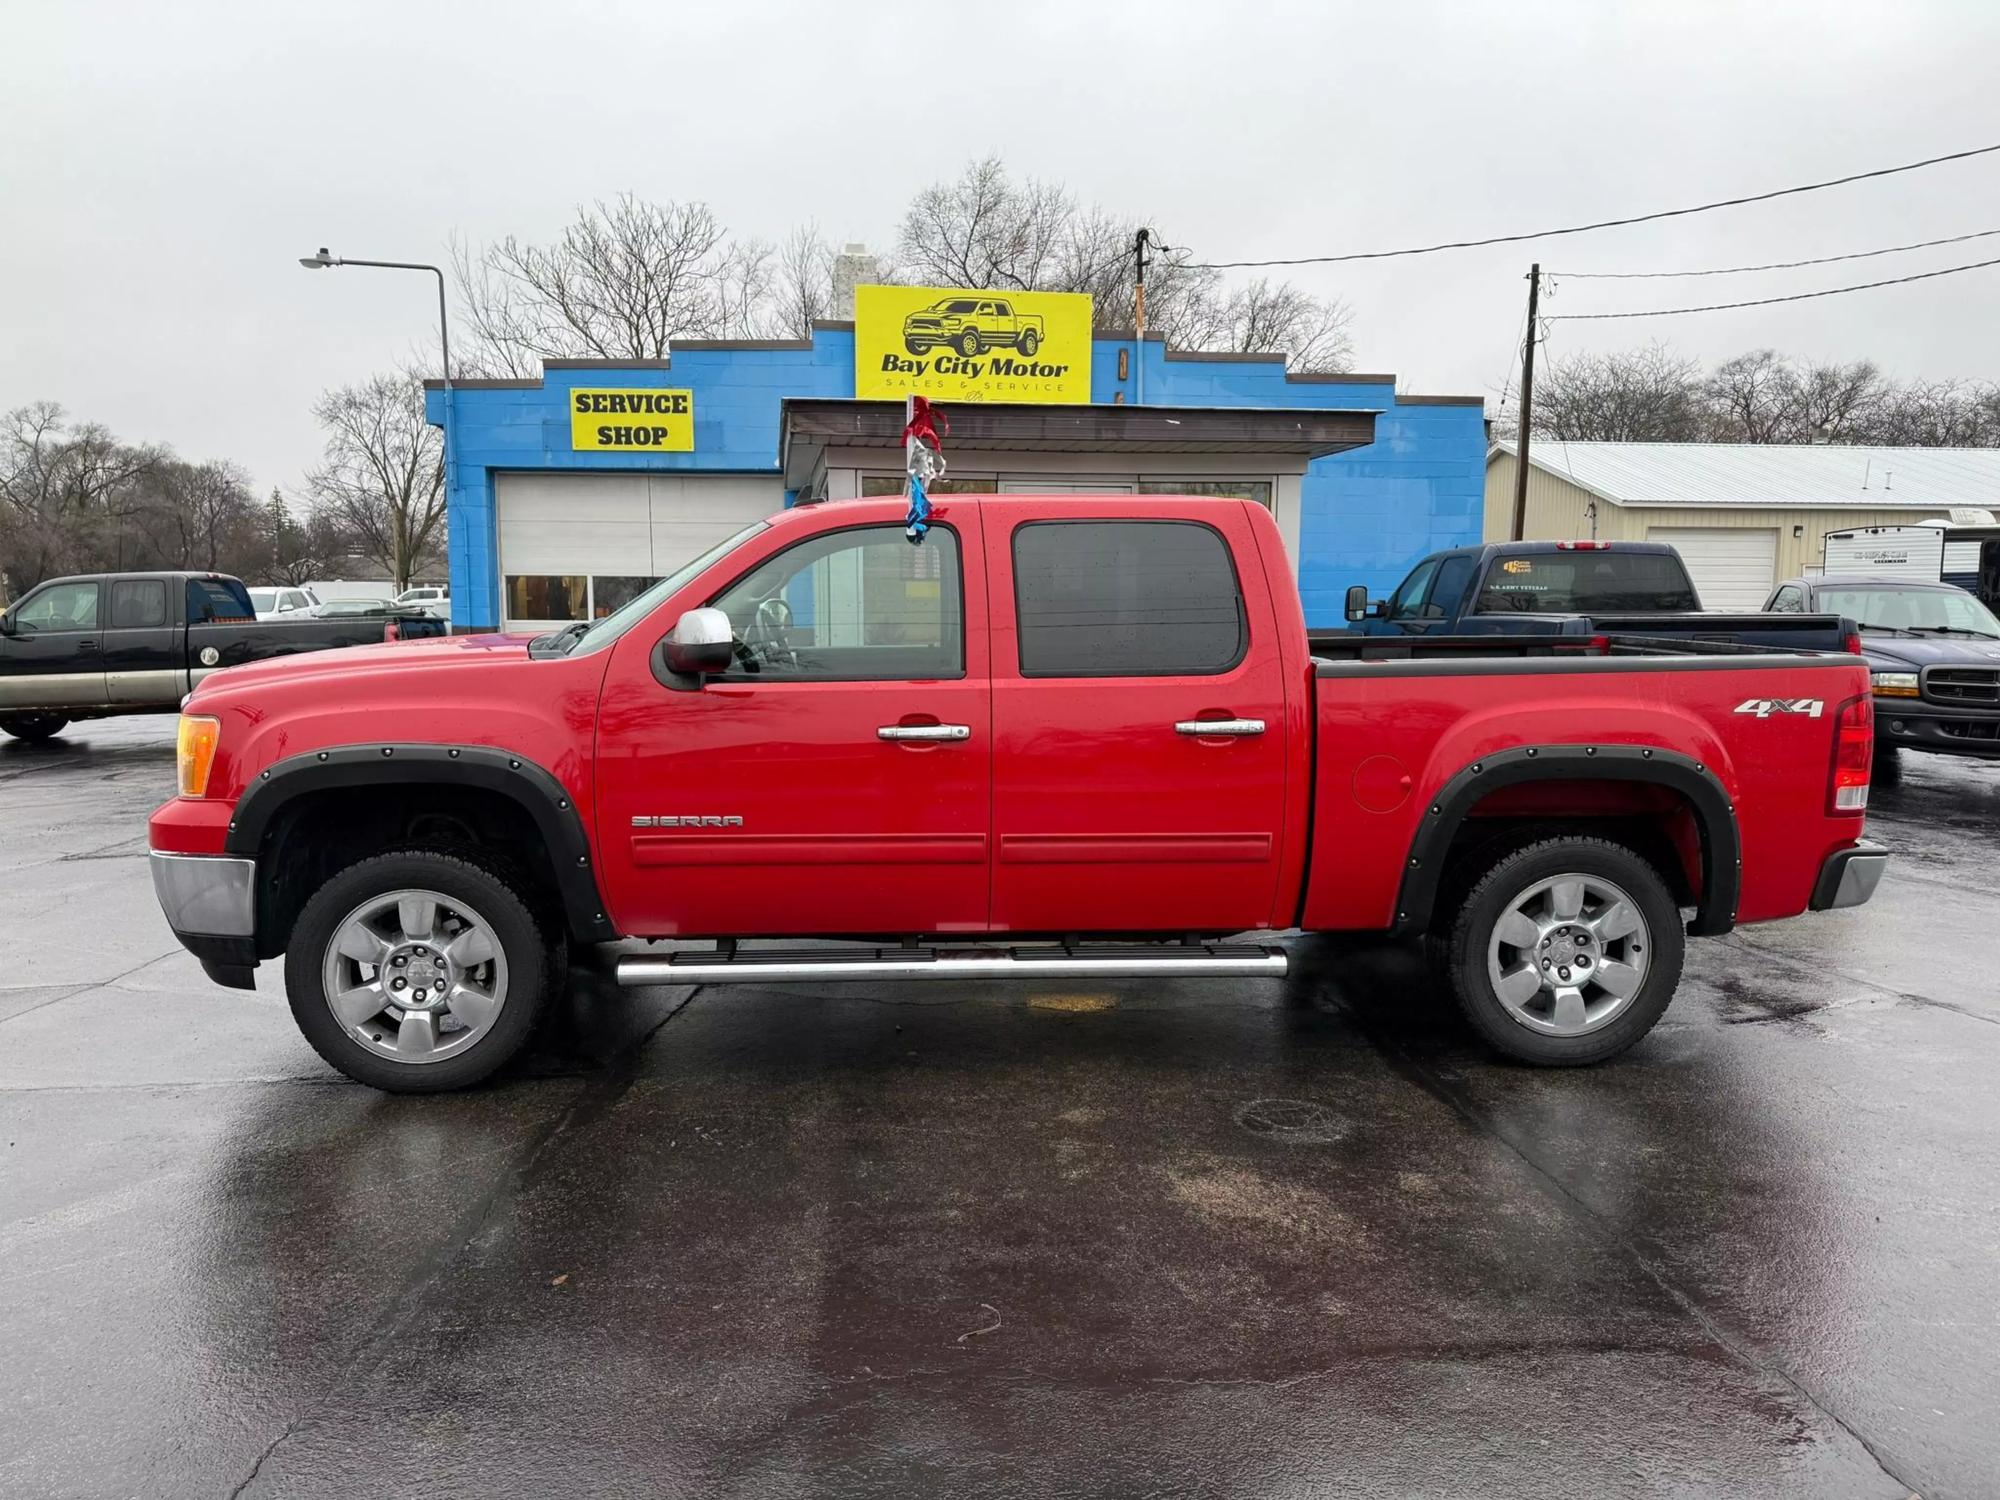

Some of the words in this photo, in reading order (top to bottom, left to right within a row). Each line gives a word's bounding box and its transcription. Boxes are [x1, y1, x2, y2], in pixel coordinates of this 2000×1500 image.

[881, 354, 930, 377] Bay
[934, 357, 985, 379] City
[989, 358, 1069, 378] Motor
[886, 379, 945, 389] SALES
[984, 382, 1065, 392] SERVICE
[575, 394, 688, 414] SERVICE
[597, 426, 668, 445] SHOP
[631, 816, 743, 827] SIERRA
